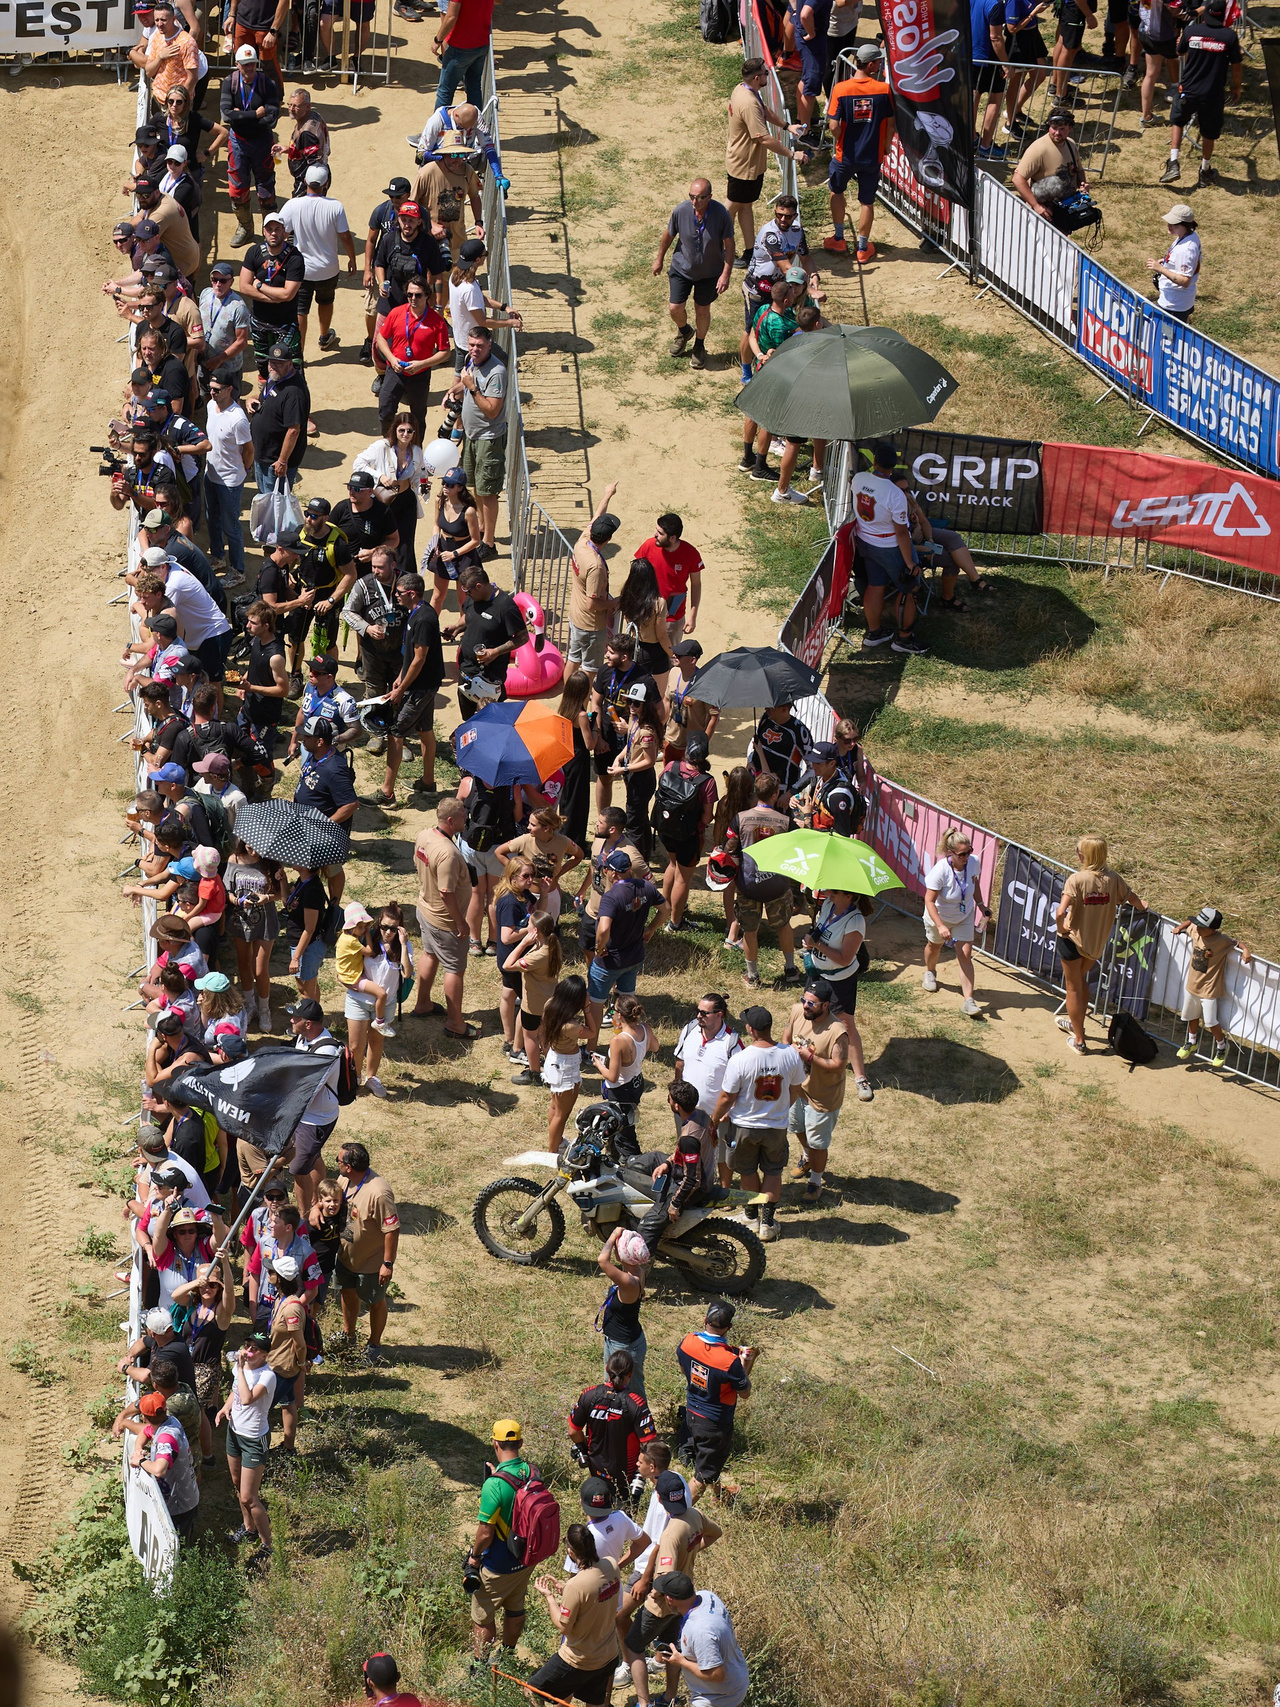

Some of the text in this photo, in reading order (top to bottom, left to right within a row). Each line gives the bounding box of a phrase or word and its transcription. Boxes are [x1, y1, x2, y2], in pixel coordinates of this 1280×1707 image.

[912, 453, 1039, 490] GRIP
[926, 491, 950, 503] ON
[957, 494, 1014, 507] TRACK
[780, 863, 808, 876] GRIP
[874, 875, 890, 886] GRIP
